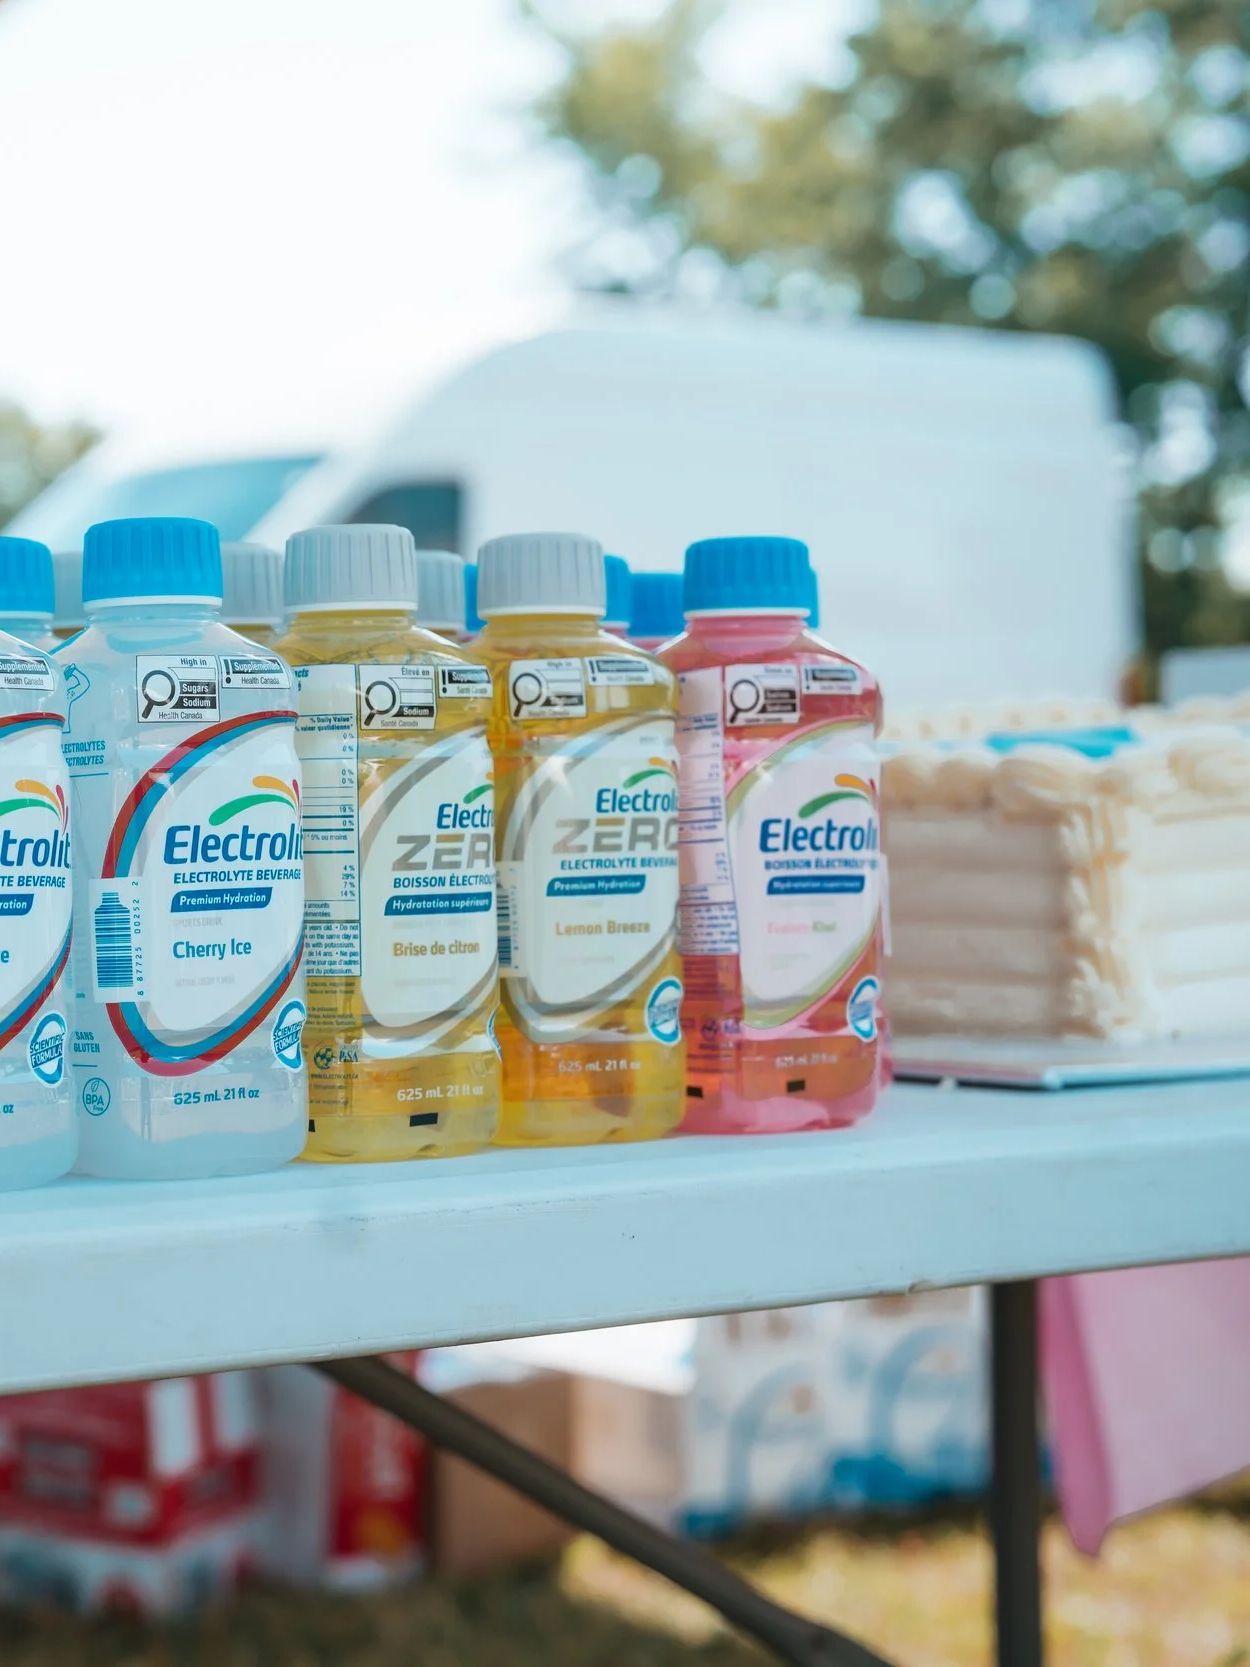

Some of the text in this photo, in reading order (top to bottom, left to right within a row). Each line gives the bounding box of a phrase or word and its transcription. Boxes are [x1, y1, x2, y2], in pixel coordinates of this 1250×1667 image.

[180, 657, 207, 667] High in
[234, 661, 281, 672] Supplemented
[3, 676, 44, 686] Health Canada
[241, 676, 280, 685] Health Canada
[182, 683, 209, 695] Sugars
[183, 697, 211, 707] Sodium
[158, 711, 203, 720] Health Canada
[403, 707, 430, 716] Sodium
[316, 716, 332, 724] Daily
[380, 719, 397, 727] Santé
[561, 858, 637, 870] ELECTROLYTE
[764, 858, 811, 871] BOISSON
[17, 875, 66, 888] BEVERAGE
[174, 868, 301, 884] ELECTROLYTE BEVERAGE
[393, 876, 445, 889] BOISSON
[554, 879, 641, 891] Premium Hydration
[179, 894, 266, 906] Premium Hydration
[393, 897, 489, 911] Hydratation supérieure
[555, 920, 651, 936] Lemon Breeze
[133, 899, 144, 982] 87725 00252
[342, 933, 352, 941] day
[173, 938, 252, 961] Cherry Ice
[393, 940, 480, 957] Brise de citron
[75, 1031, 95, 1041] SANS
[273, 1020, 303, 1040] SCIENTI
[29, 1032, 65, 1054] SCIENTIFIC
[275, 1030, 300, 1052] FORMU
[73, 1042, 101, 1053] GLUTEN
[31, 1043, 63, 1067] FORMULA
[558, 1060, 583, 1072] 625
[585, 1060, 602, 1072] mL
[605, 1059, 618, 1070] 21
[174, 1087, 260, 1105] 625 mL 21 fl oz
[397, 1088, 423, 1101] 625
[425, 1086, 443, 1099] mL
[446, 1084, 459, 1097] 21
[462, 1084, 471, 1096] fl
[85, 1094, 105, 1106] BPA
[3, 1103, 14, 1114] oz
